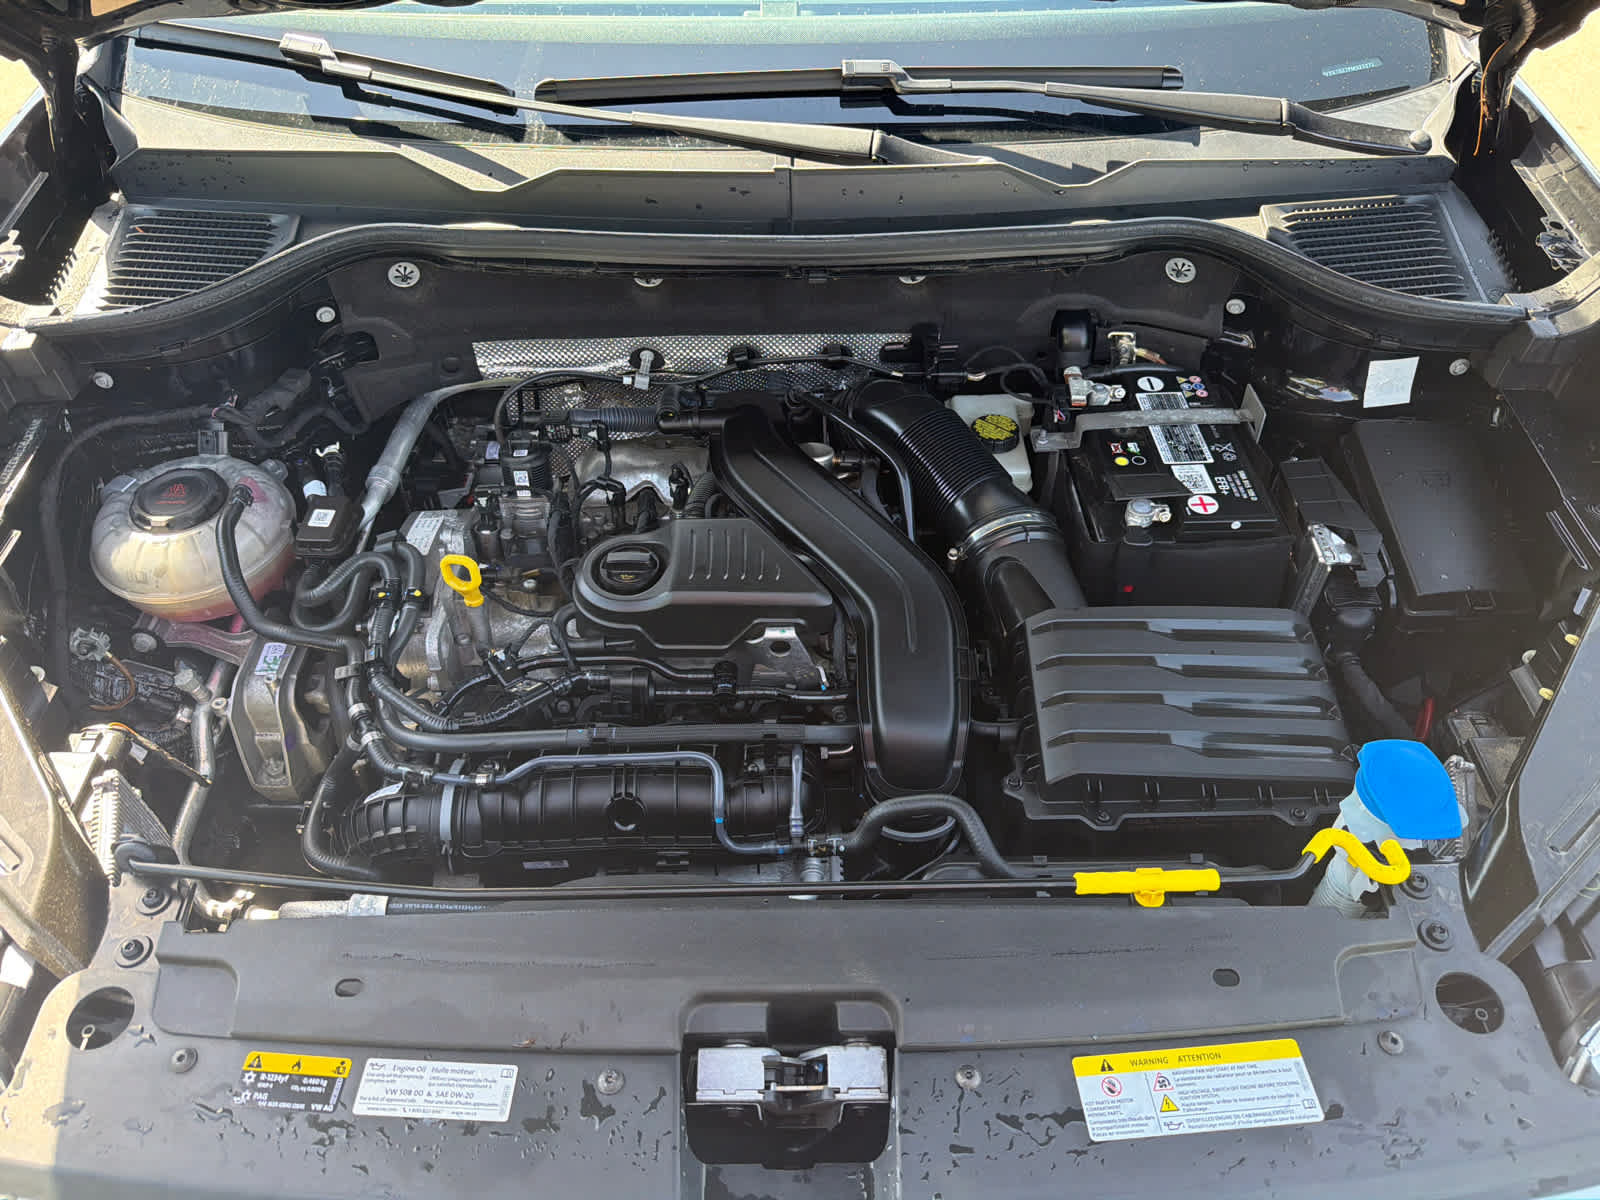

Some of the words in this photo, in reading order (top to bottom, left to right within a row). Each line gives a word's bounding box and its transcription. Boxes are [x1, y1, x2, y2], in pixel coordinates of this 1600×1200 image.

[1129, 1056, 1169, 1067] WARNING
[1177, 1052, 1222, 1063] ATTENTION
[392, 1064, 416, 1074] Engine
[417, 1065, 427, 1073] Oil
[252, 1092, 269, 1100] PAG
[399, 1088, 413, 1097] 508
[413, 1089, 424, 1097] 00
[450, 1091, 475, 1099] 0W-20
[323, 1104, 334, 1112] AG
